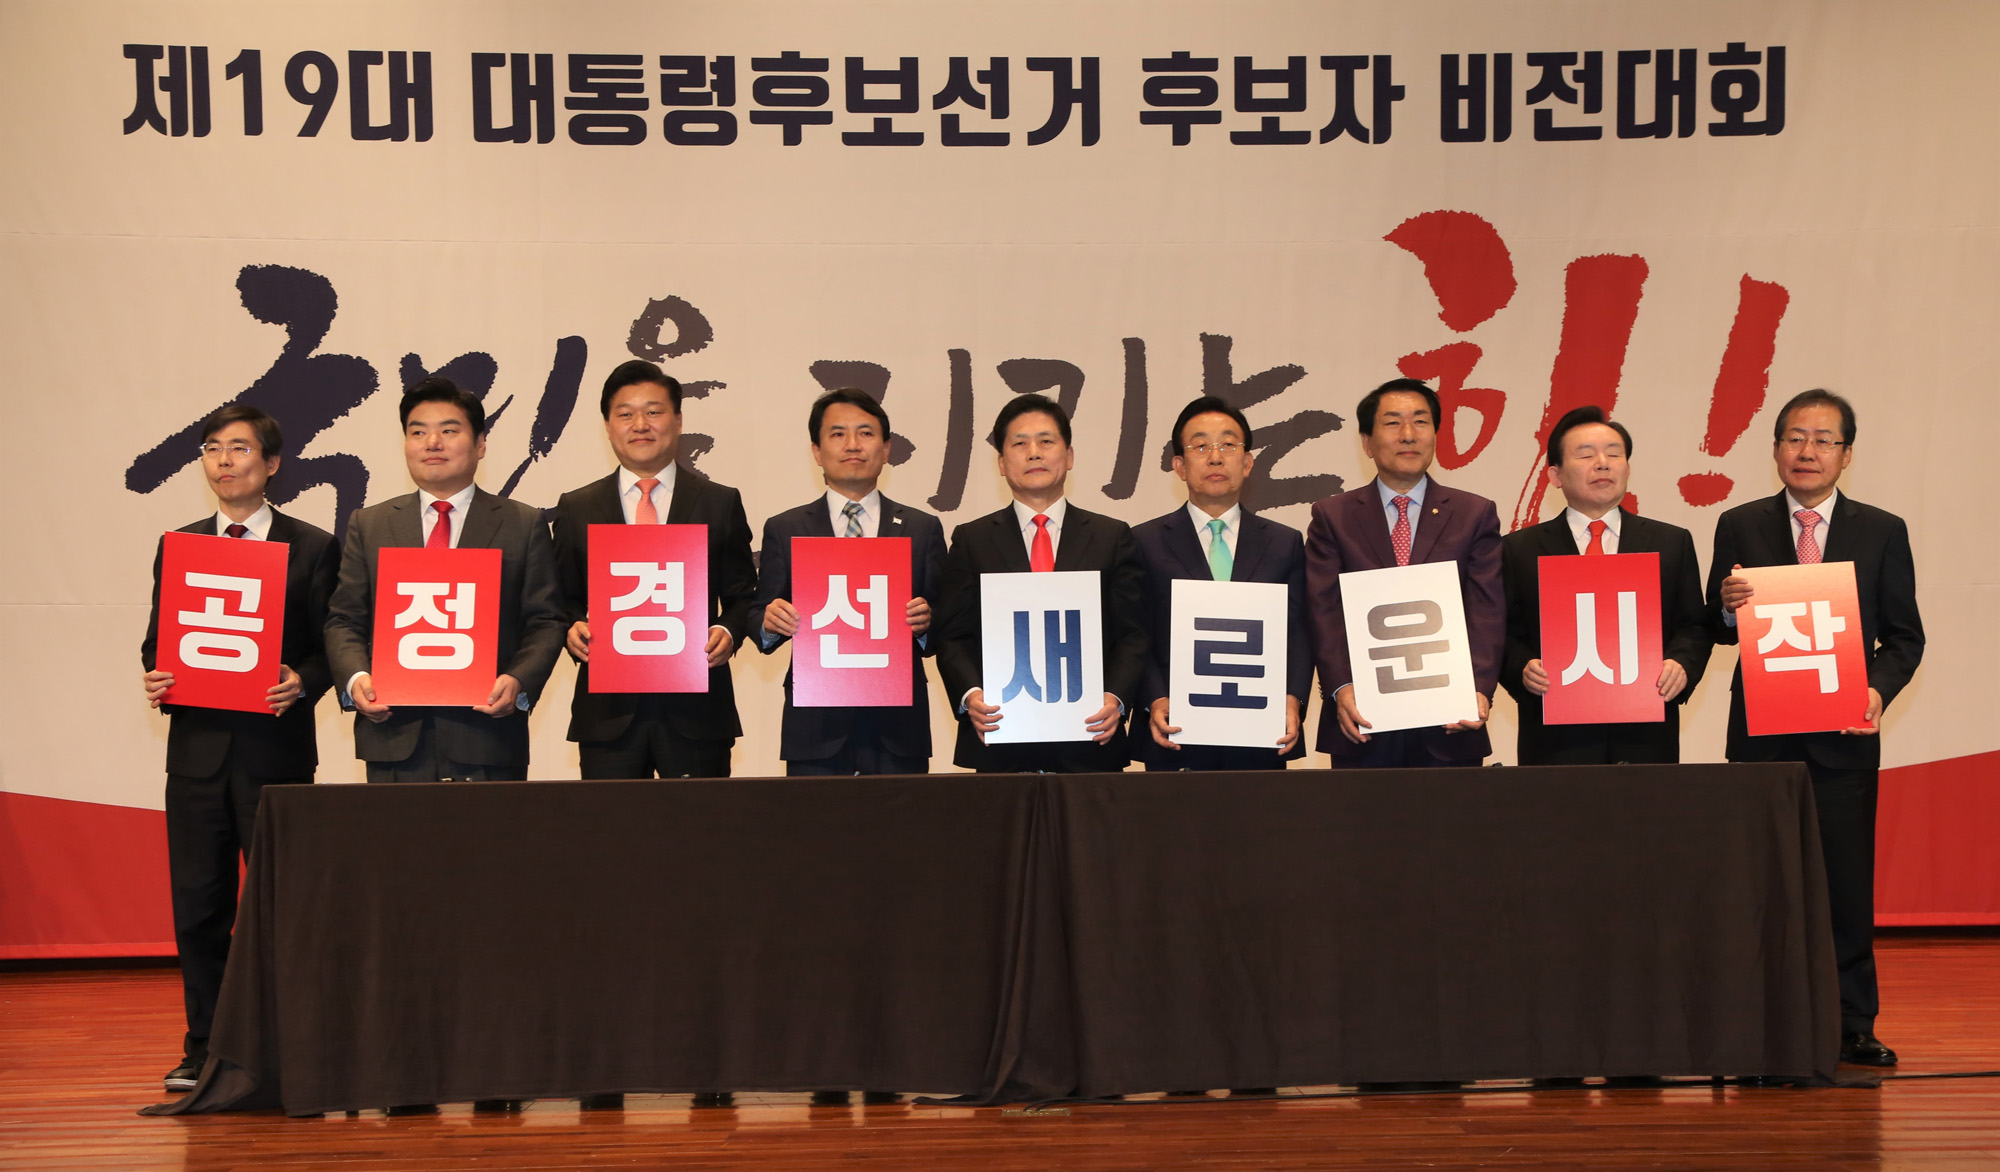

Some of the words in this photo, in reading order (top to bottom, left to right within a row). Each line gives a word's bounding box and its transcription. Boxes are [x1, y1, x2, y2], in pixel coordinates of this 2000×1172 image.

[123, 43, 433, 142] 제19대
[471, 50, 1100, 146] 대통령후보선거
[1139, 50, 1405, 146] 후보자
[1440, 41, 1786, 142] 비전대회
[179, 572, 263, 672] 공
[395, 583, 475, 669] 정
[611, 562, 685, 655] 경
[812, 575, 888, 668] 선
[1367, 600, 1449, 694] 운
[1562, 592, 1638, 685] 시
[1754, 601, 1846, 694] 작
[1003, 610, 1082, 703] 새
[1189, 617, 1268, 709] 로
